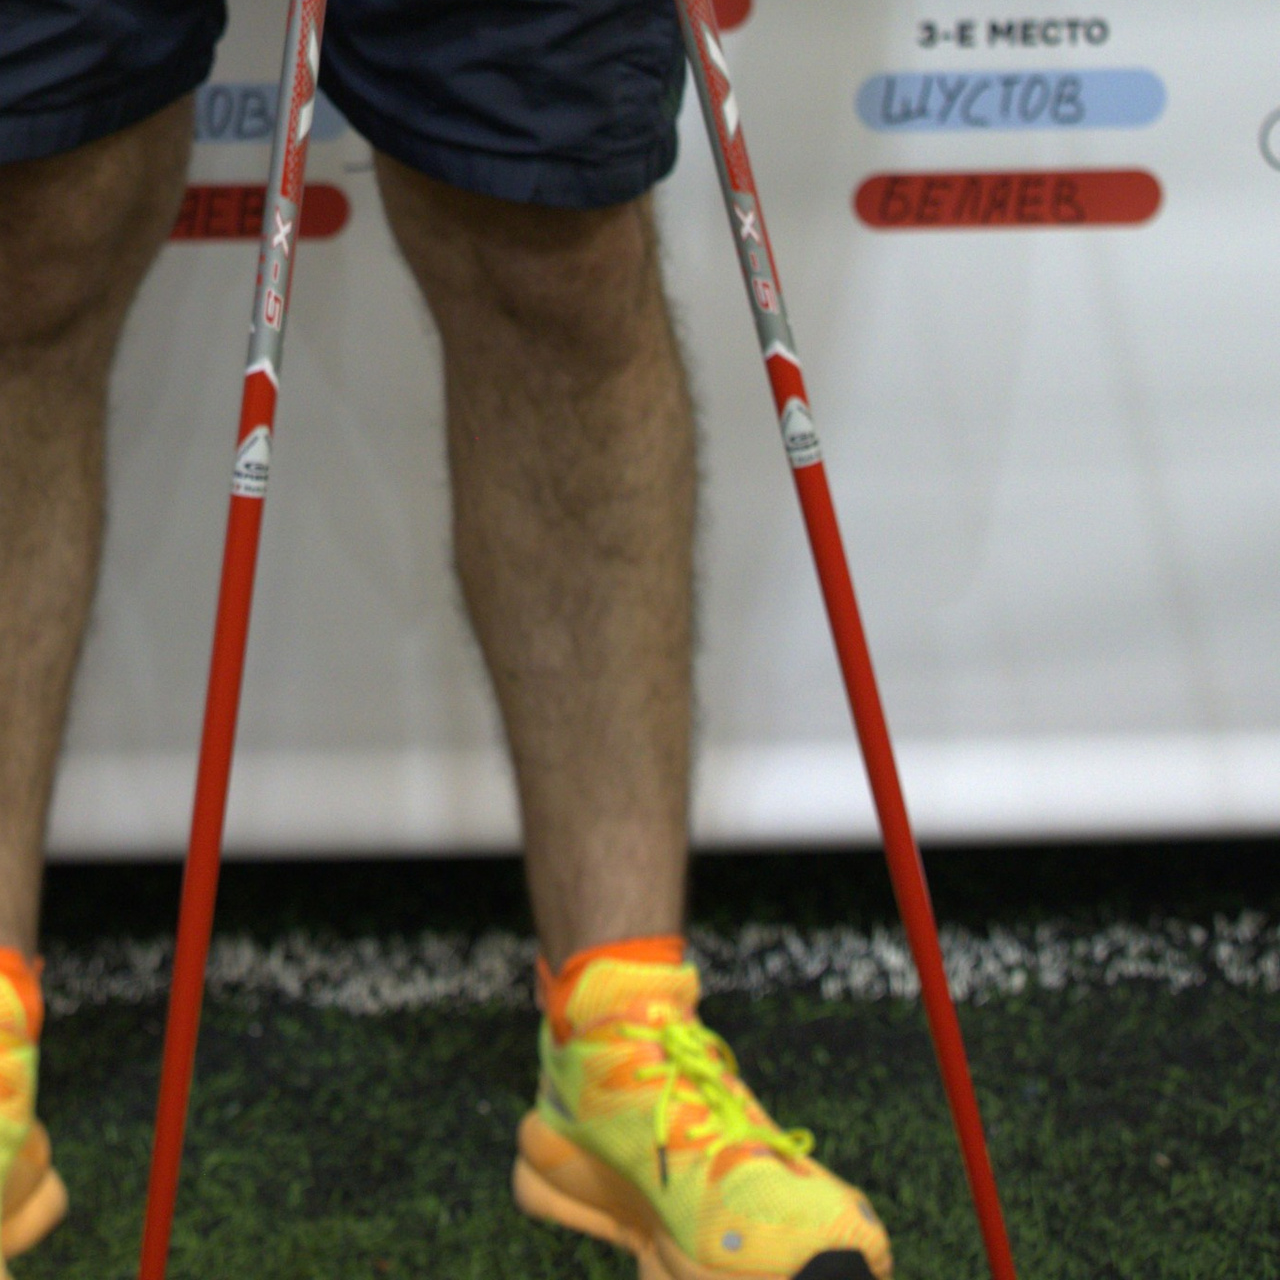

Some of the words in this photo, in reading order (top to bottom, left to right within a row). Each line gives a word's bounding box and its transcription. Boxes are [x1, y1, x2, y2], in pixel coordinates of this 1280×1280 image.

[987, 16, 1111, 47] МЕСТО
[879, 72, 1086, 128] ШУСТОВ
[878, 176, 1086, 226] БЕЛЯЕВ
